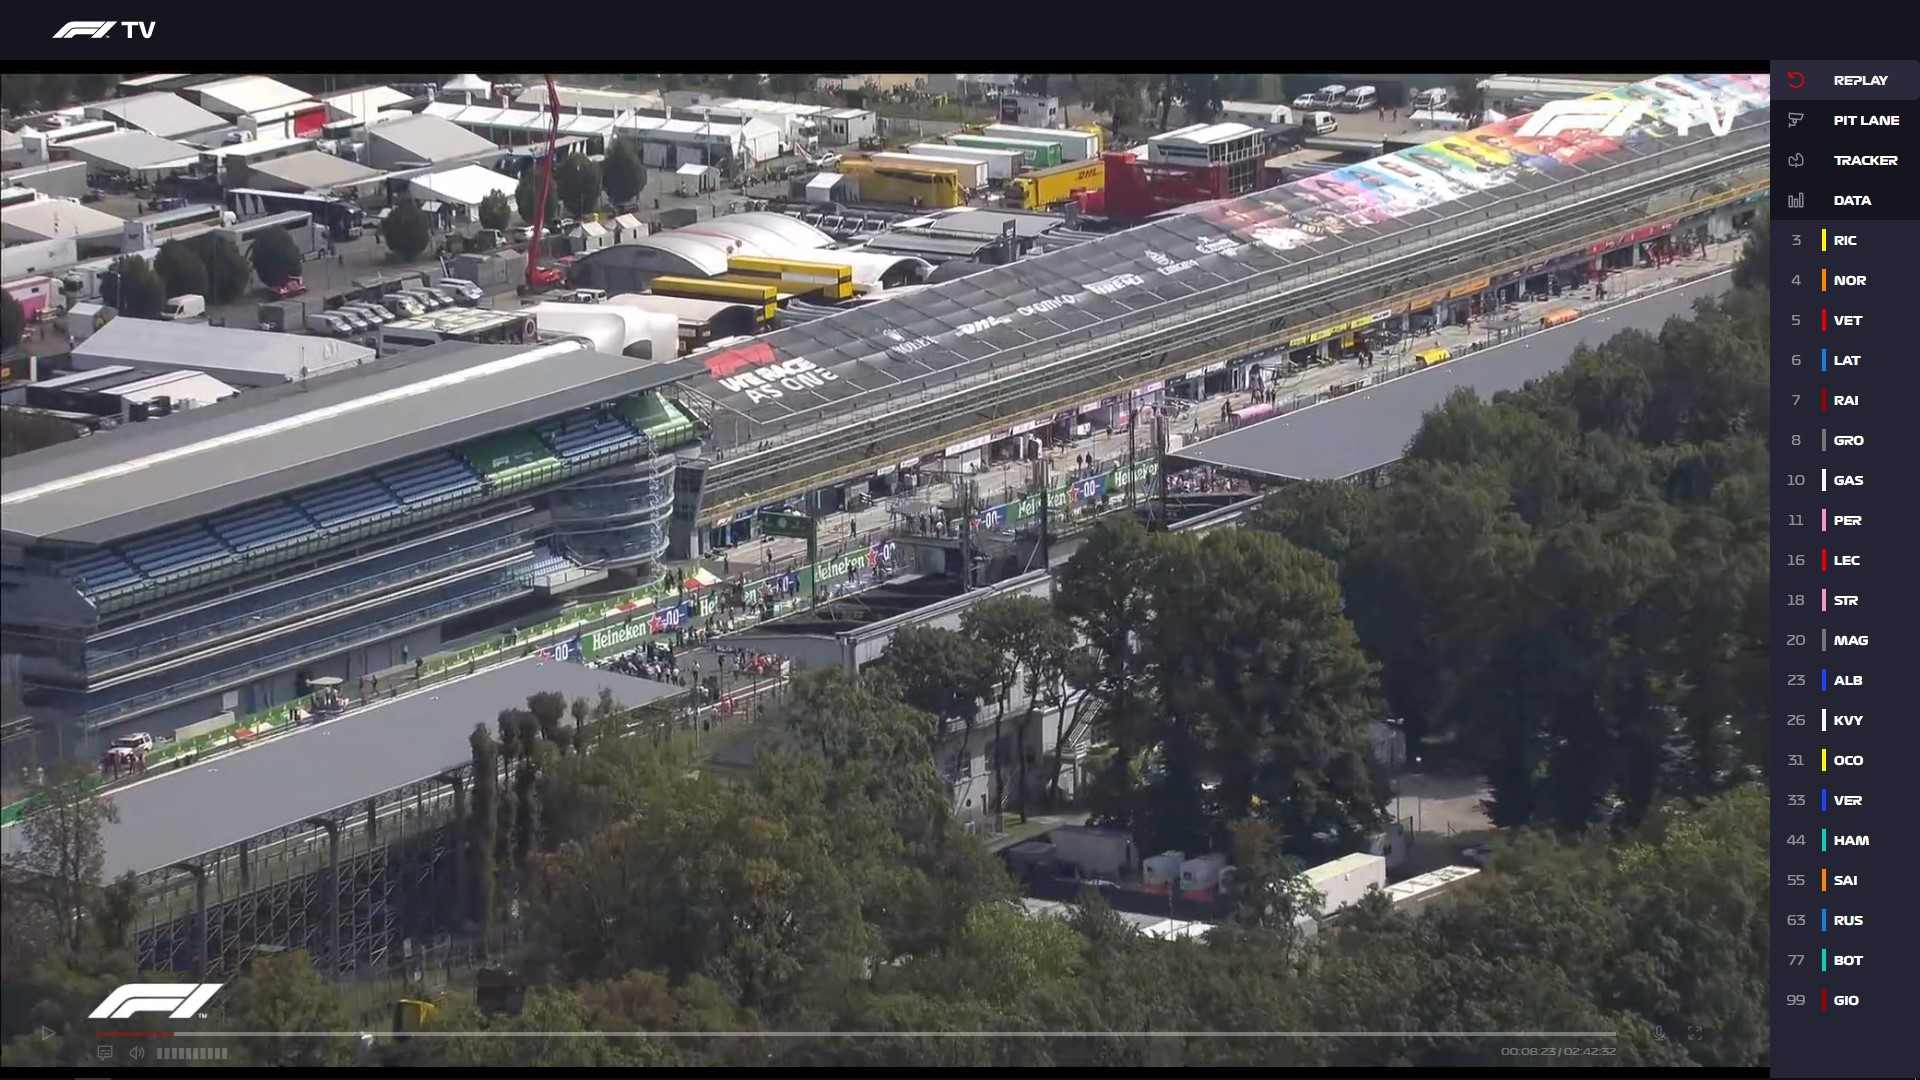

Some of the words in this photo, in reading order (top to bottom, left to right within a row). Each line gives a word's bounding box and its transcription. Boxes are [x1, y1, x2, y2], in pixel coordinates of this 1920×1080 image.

[745, 383, 784, 404] AS
[780, 366, 839, 391] ONE
[756, 356, 818, 384] RACE
[592, 621, 648, 651] Heineken
